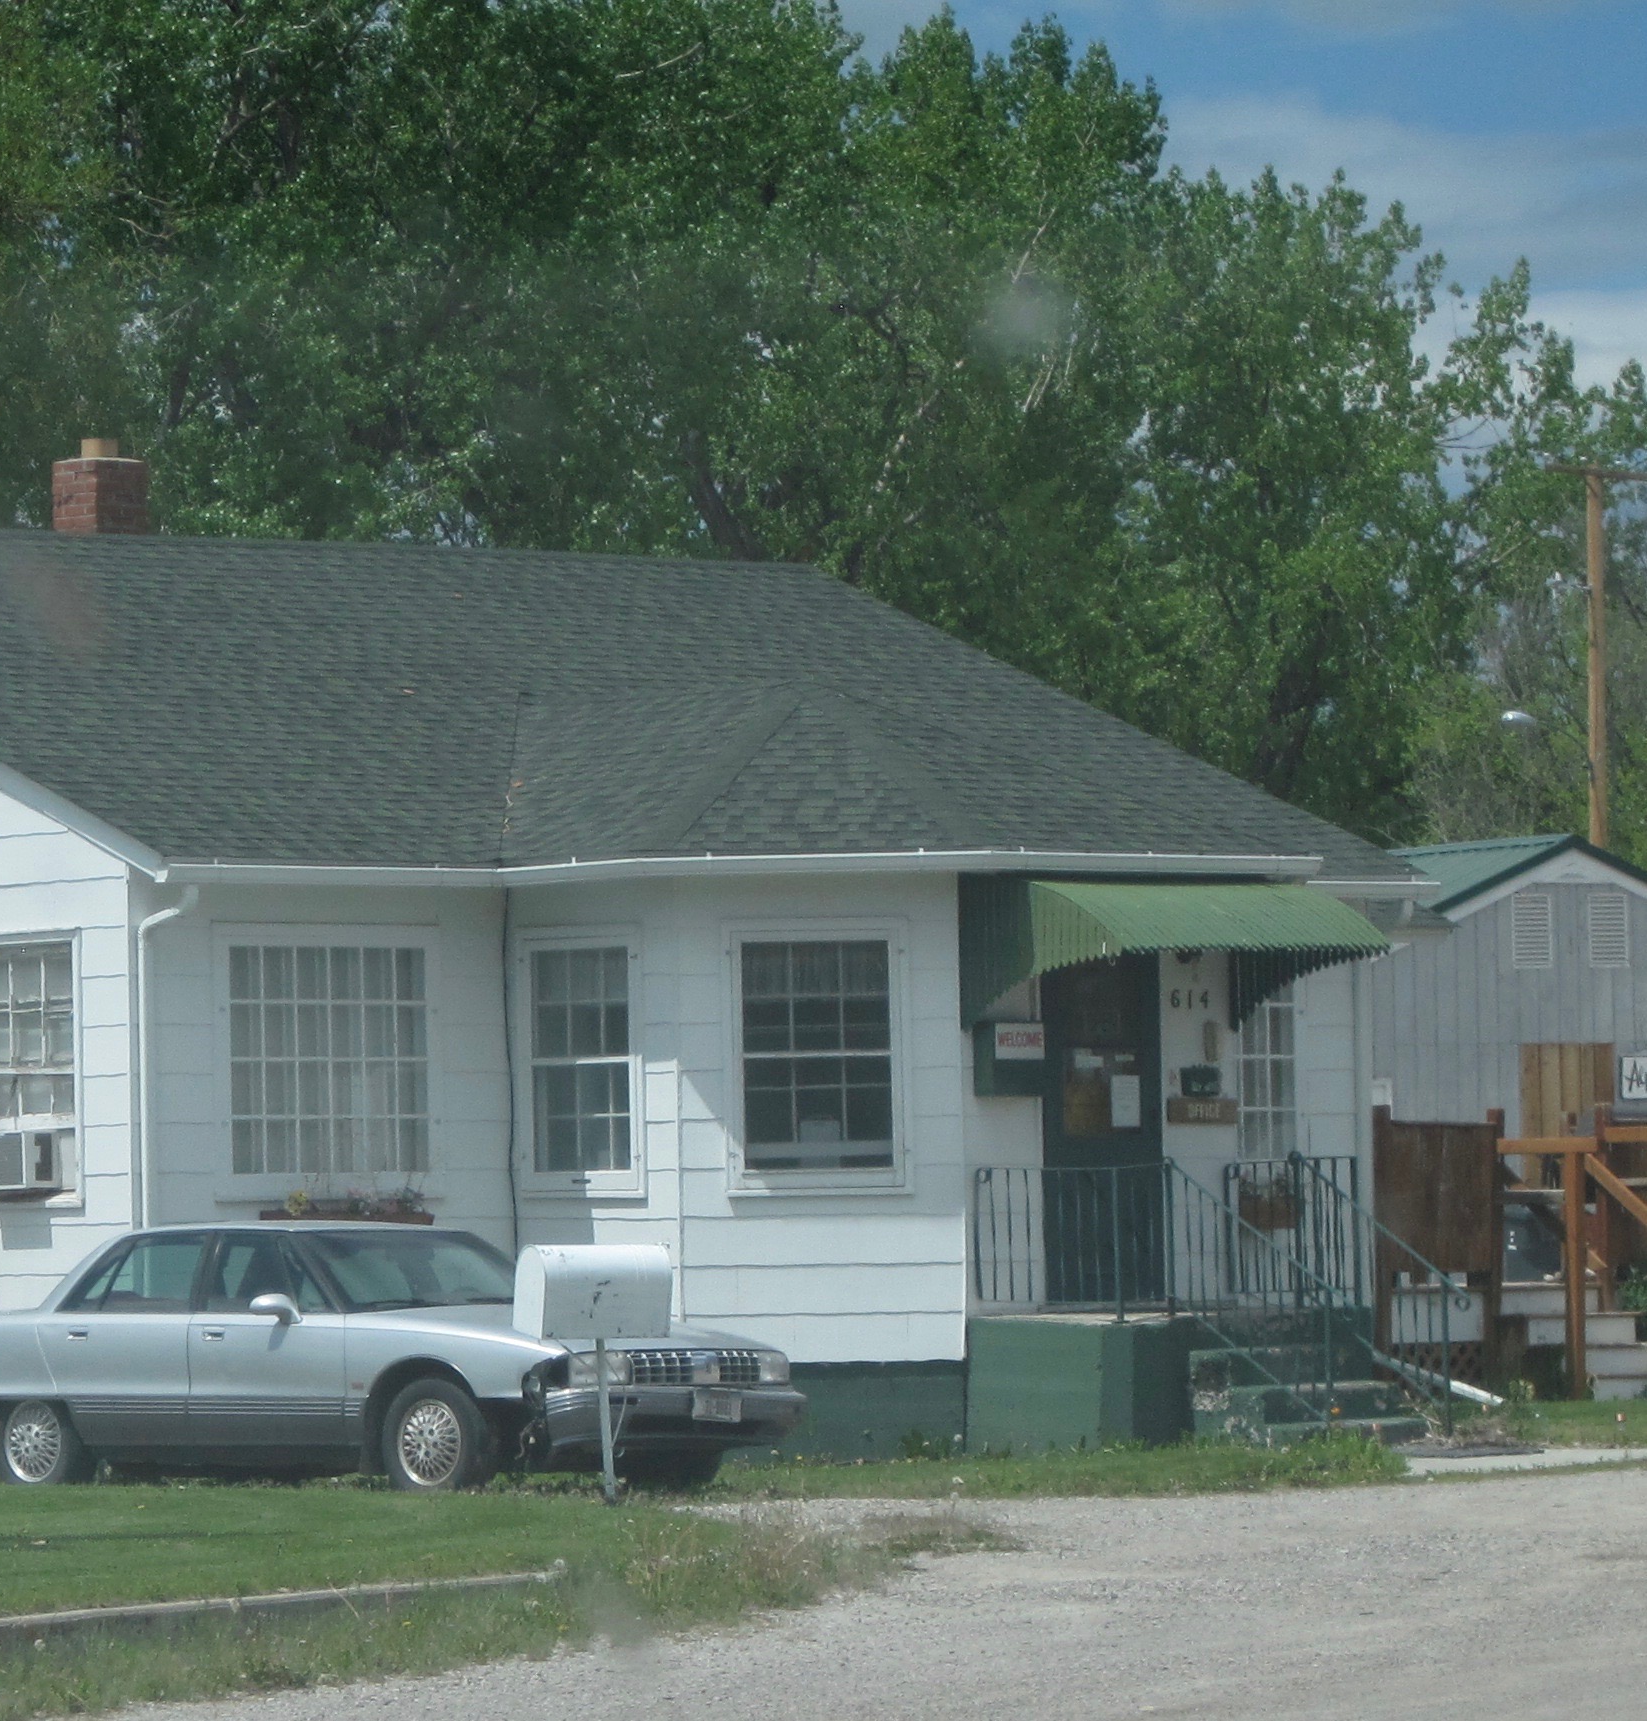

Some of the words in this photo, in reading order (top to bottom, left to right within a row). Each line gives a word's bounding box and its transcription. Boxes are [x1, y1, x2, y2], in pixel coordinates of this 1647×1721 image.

[1170, 988, 1208, 1009] 614
[996, 1031, 1043, 1048] WELCOME
[1187, 1103, 1221, 1119] OFFICE
